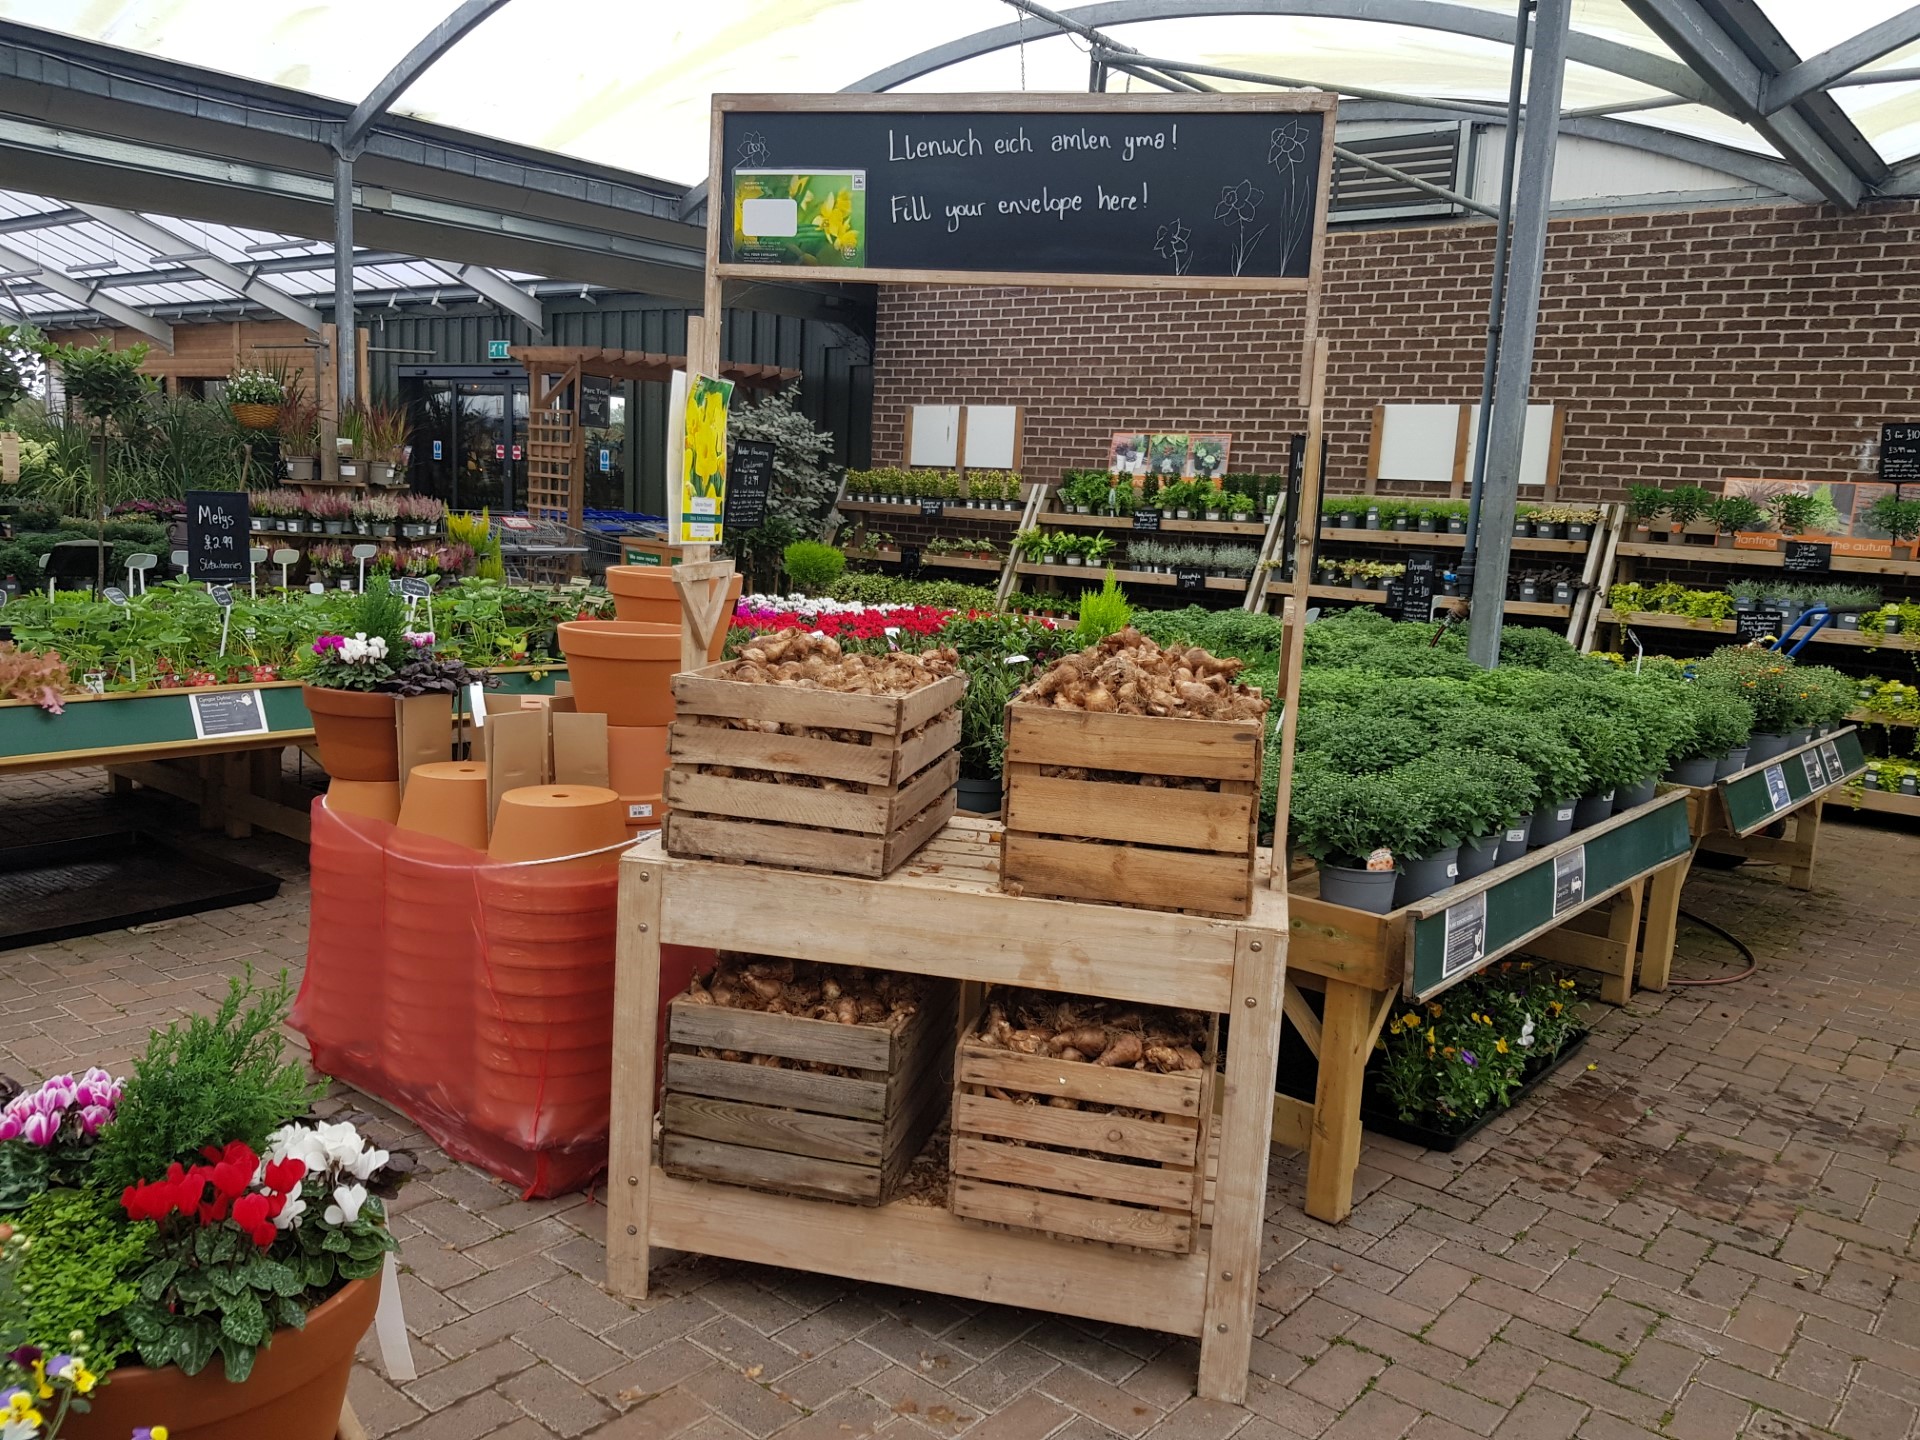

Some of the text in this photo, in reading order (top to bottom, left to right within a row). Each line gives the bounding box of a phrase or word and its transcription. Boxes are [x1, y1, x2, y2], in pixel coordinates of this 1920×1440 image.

[889, 123, 1177, 161] Llenwch eich amlen yma!
[890, 182, 1148, 233] Fill your envelope here!
[1884, 429, 1891, 441] 3
[1895, 430, 1904, 439] for
[198, 504, 235, 530] Mefys
[203, 534, 234, 551] £2.99
[1832, 540, 1850, 550] the
[1852, 543, 1892, 553] autum
